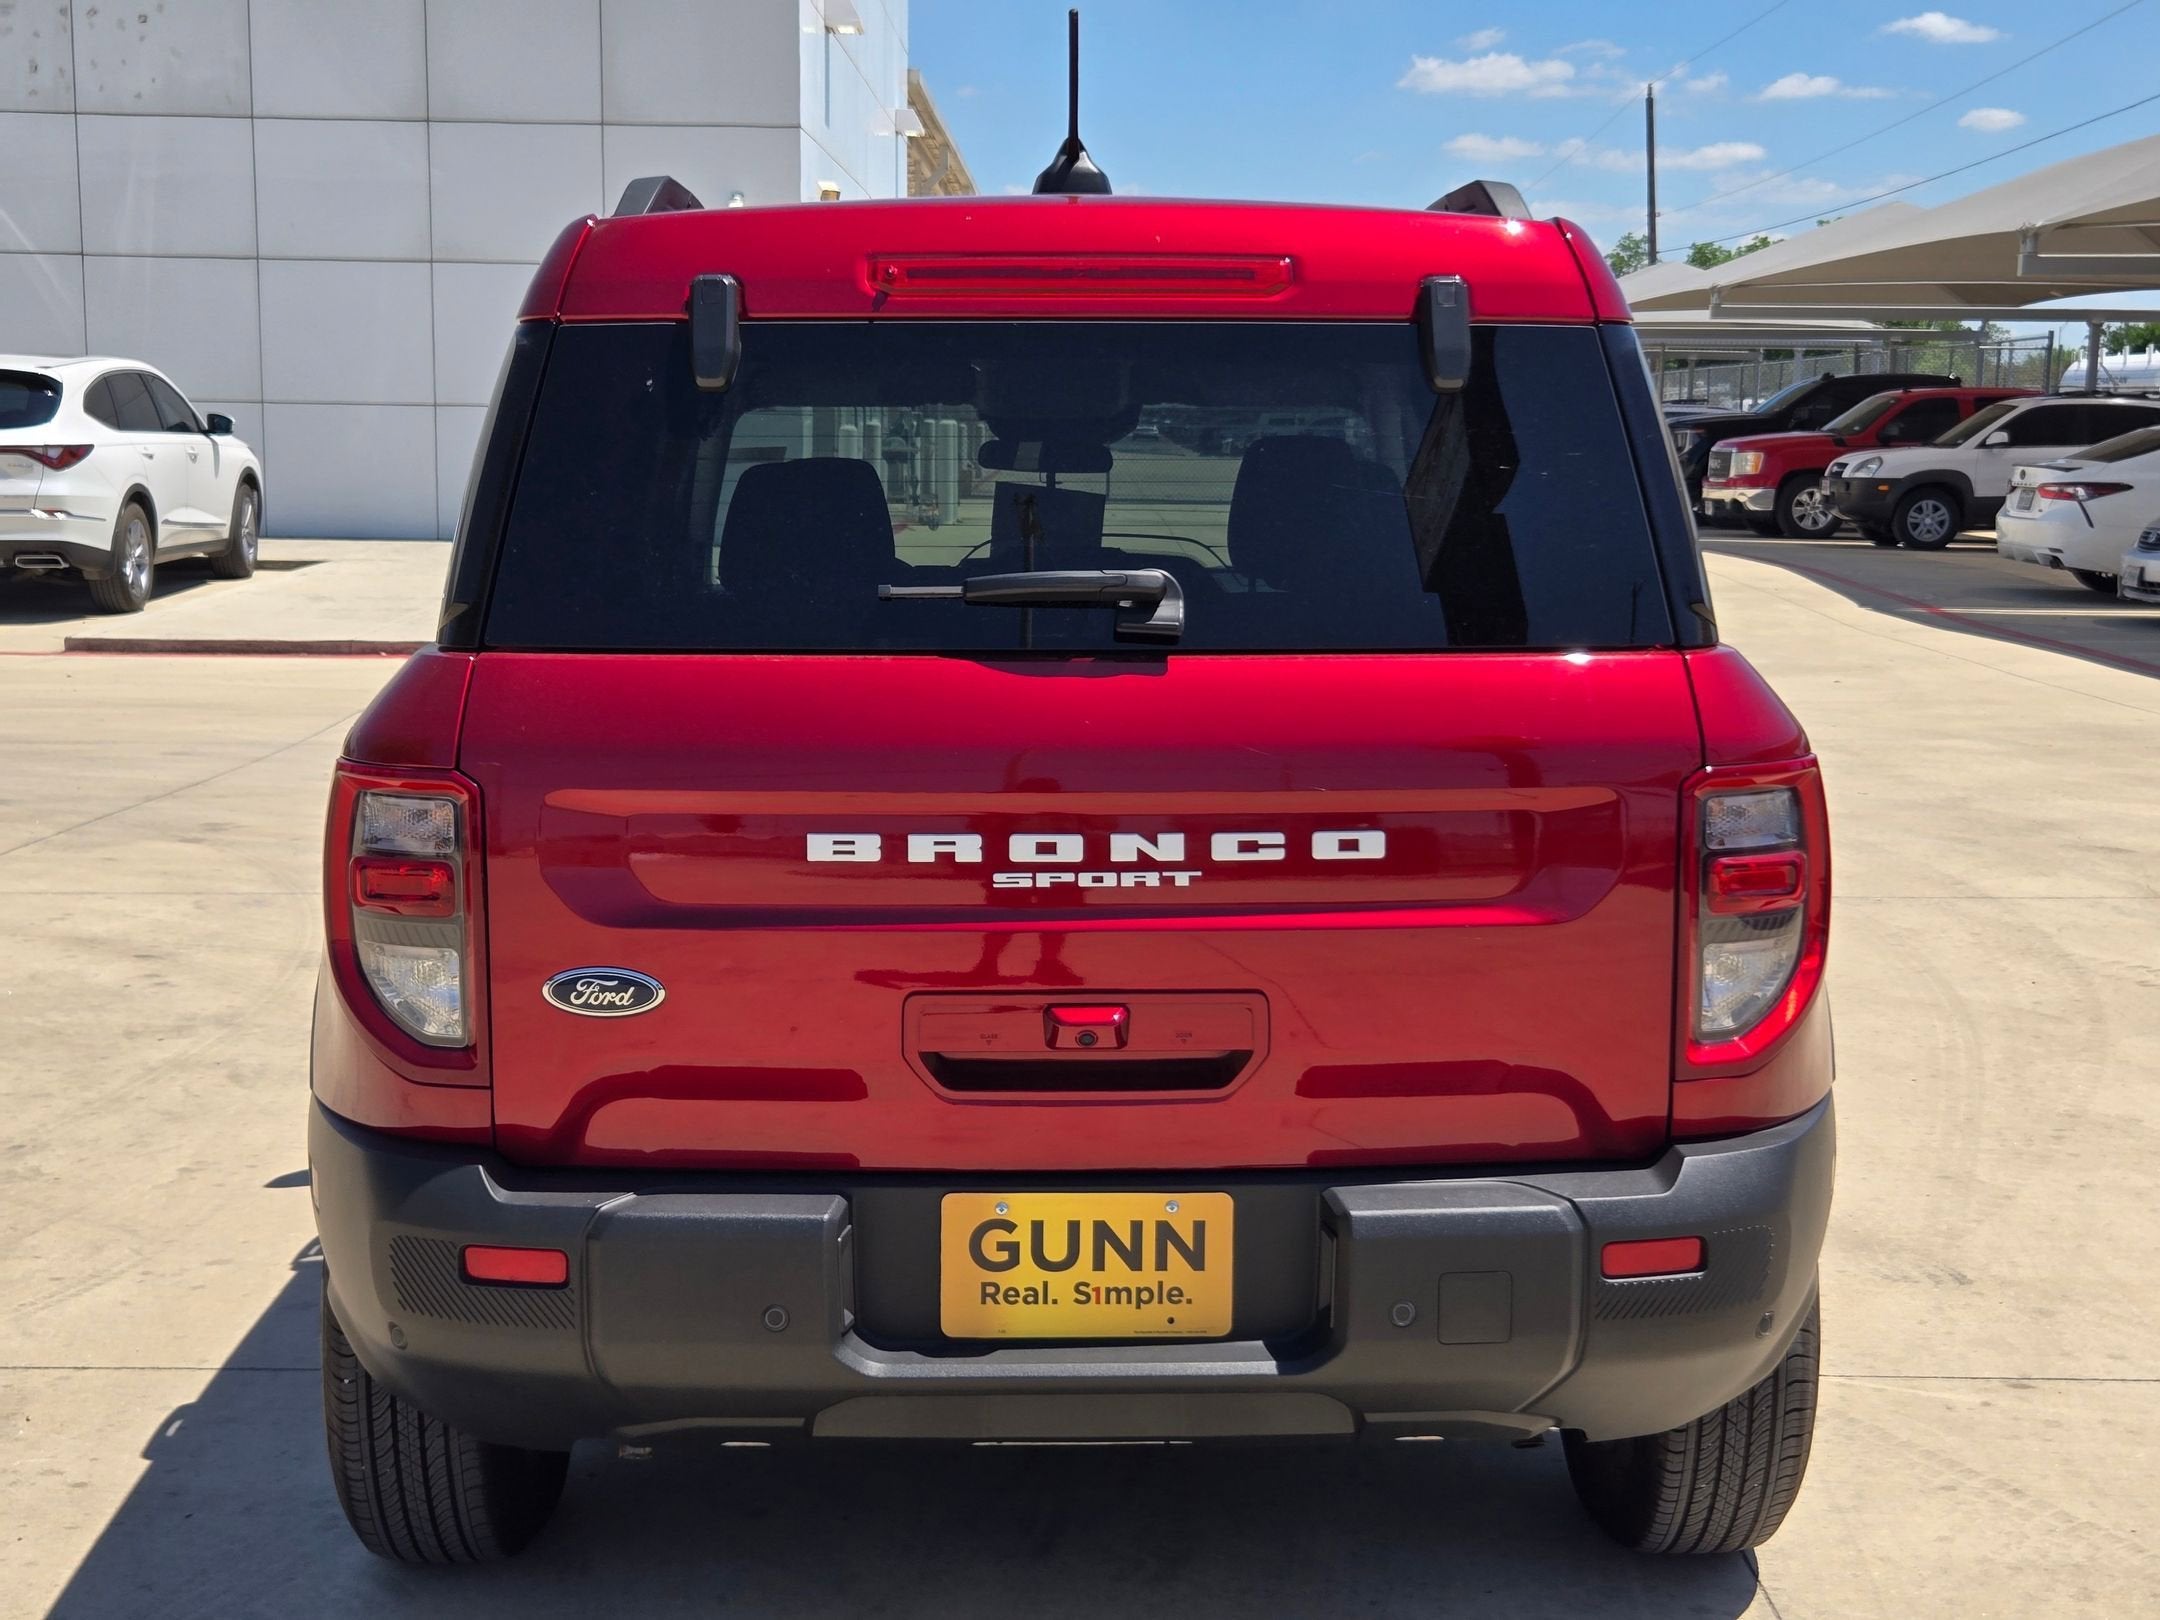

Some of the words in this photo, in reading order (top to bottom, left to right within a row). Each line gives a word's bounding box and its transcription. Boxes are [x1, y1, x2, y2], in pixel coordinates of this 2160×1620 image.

[806, 830, 1387, 863] BRONCO
[992, 870, 1202, 888] SPORT
[570, 978, 635, 1006] Ford
[968, 1217, 1206, 1272] GUNN
[980, 1280, 1059, 1305] Real.
